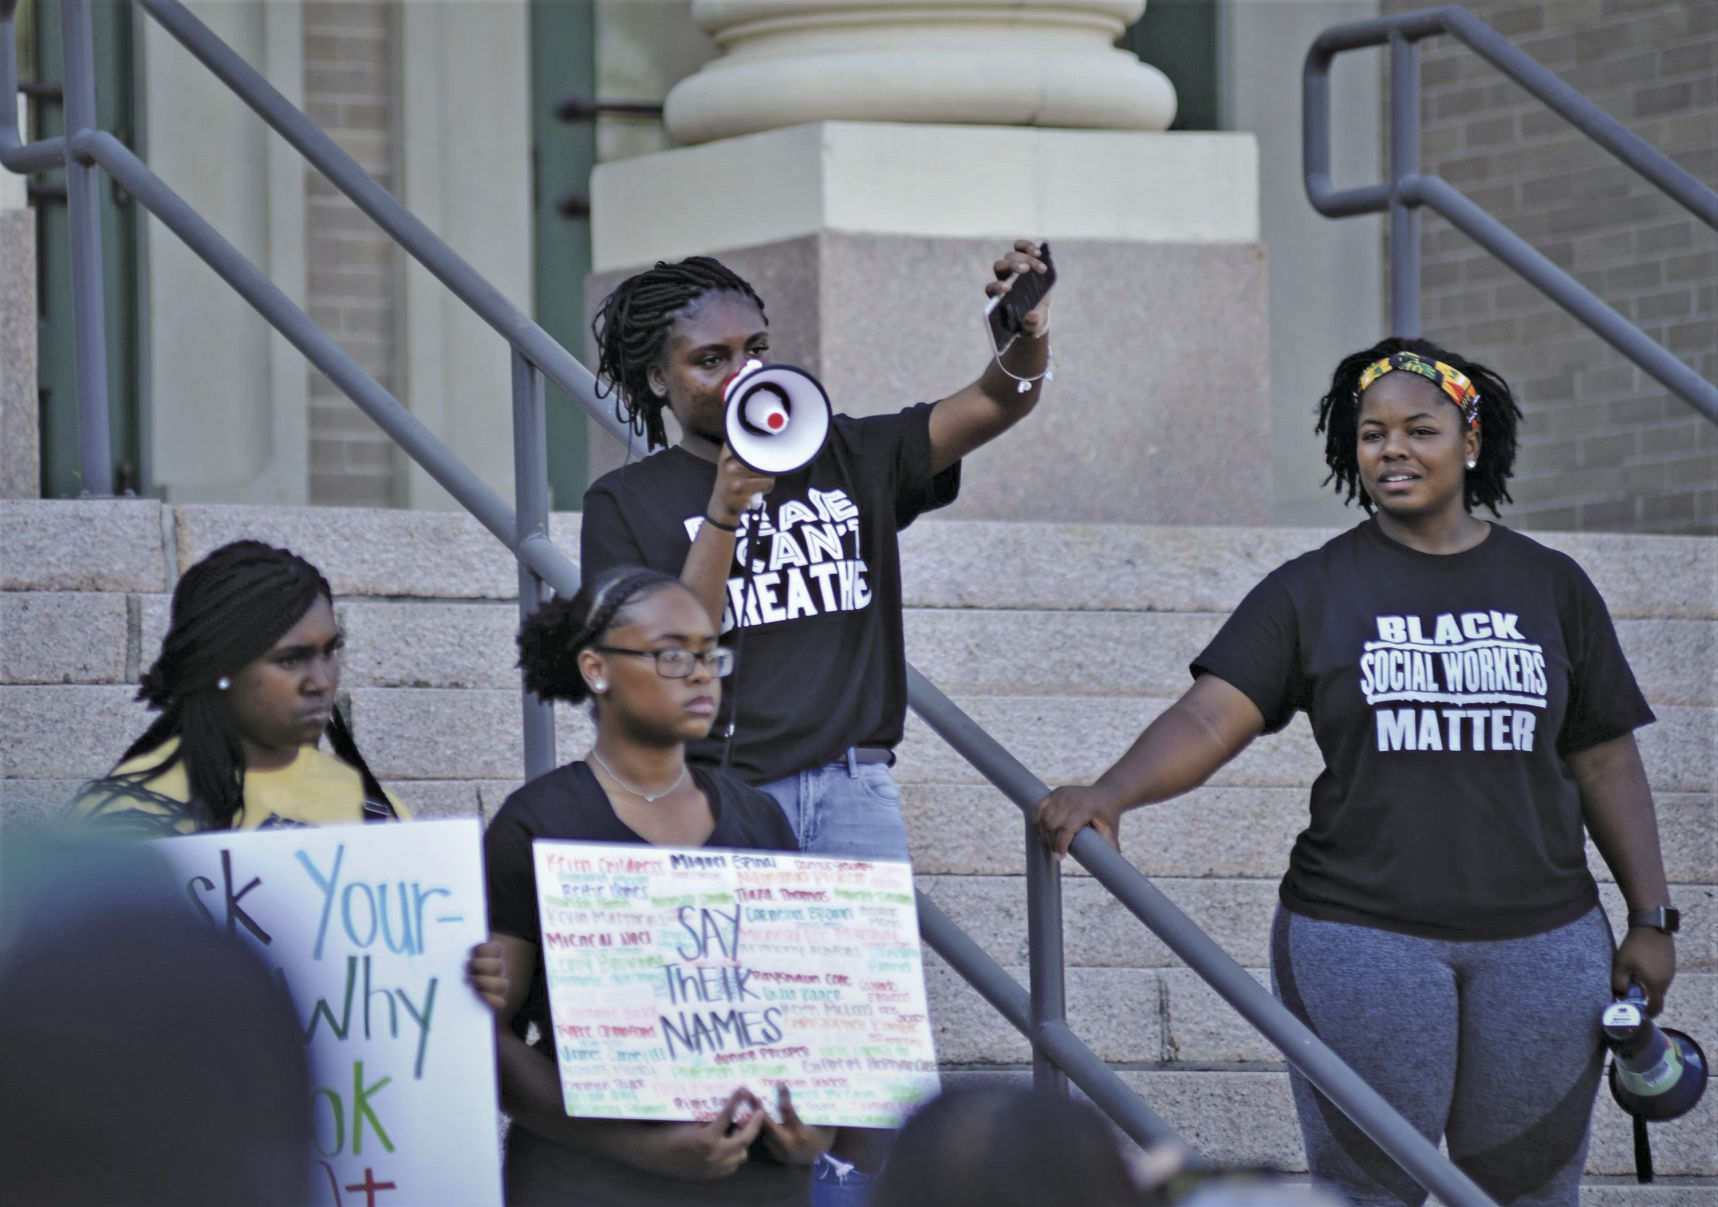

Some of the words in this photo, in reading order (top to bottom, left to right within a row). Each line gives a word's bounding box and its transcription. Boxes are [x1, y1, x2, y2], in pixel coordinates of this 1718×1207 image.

[1376, 609, 1527, 645] BLACK
[1360, 649, 1440, 696] SOCIAL
[1441, 647, 1548, 696] WORKERS
[1376, 708, 1537, 752] MATTER
[676, 903, 742, 962] SAY
[659, 1006, 784, 1061] NAMES
